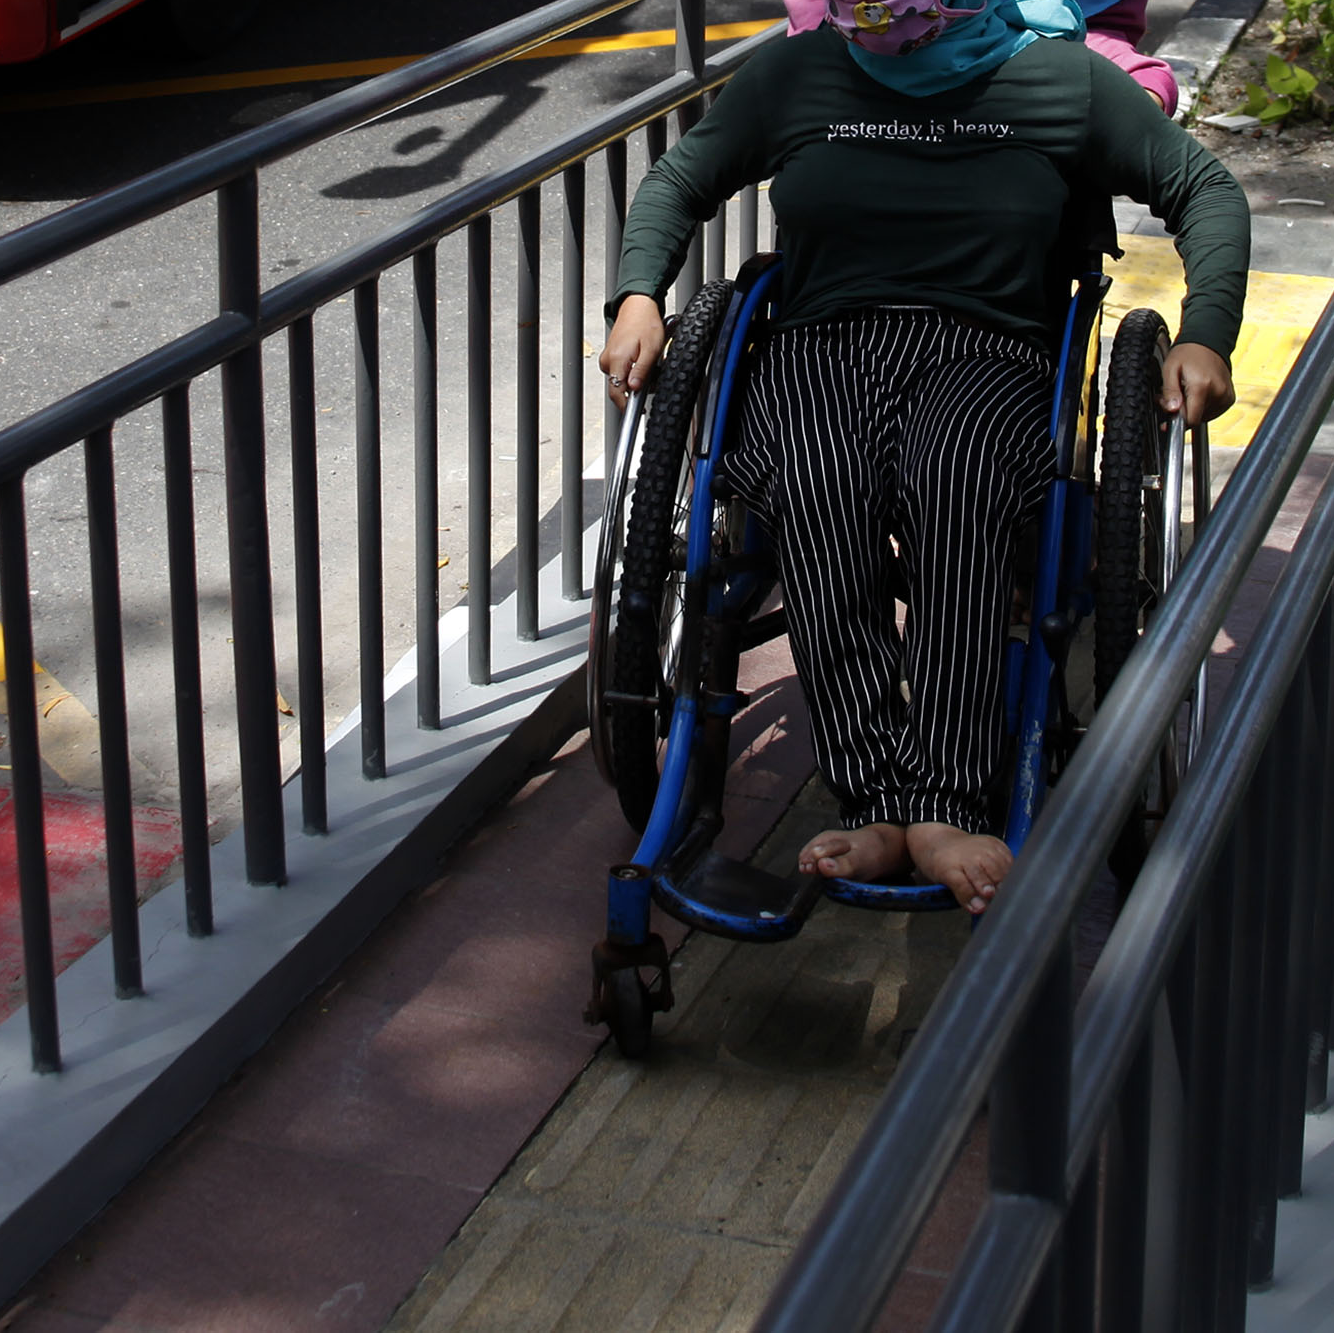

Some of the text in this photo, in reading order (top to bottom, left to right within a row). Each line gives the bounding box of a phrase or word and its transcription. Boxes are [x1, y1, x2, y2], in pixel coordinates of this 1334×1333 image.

[828, 119, 923, 138] yesterday
[929, 119, 946, 136] is
[952, 118, 1015, 138] heavy.
